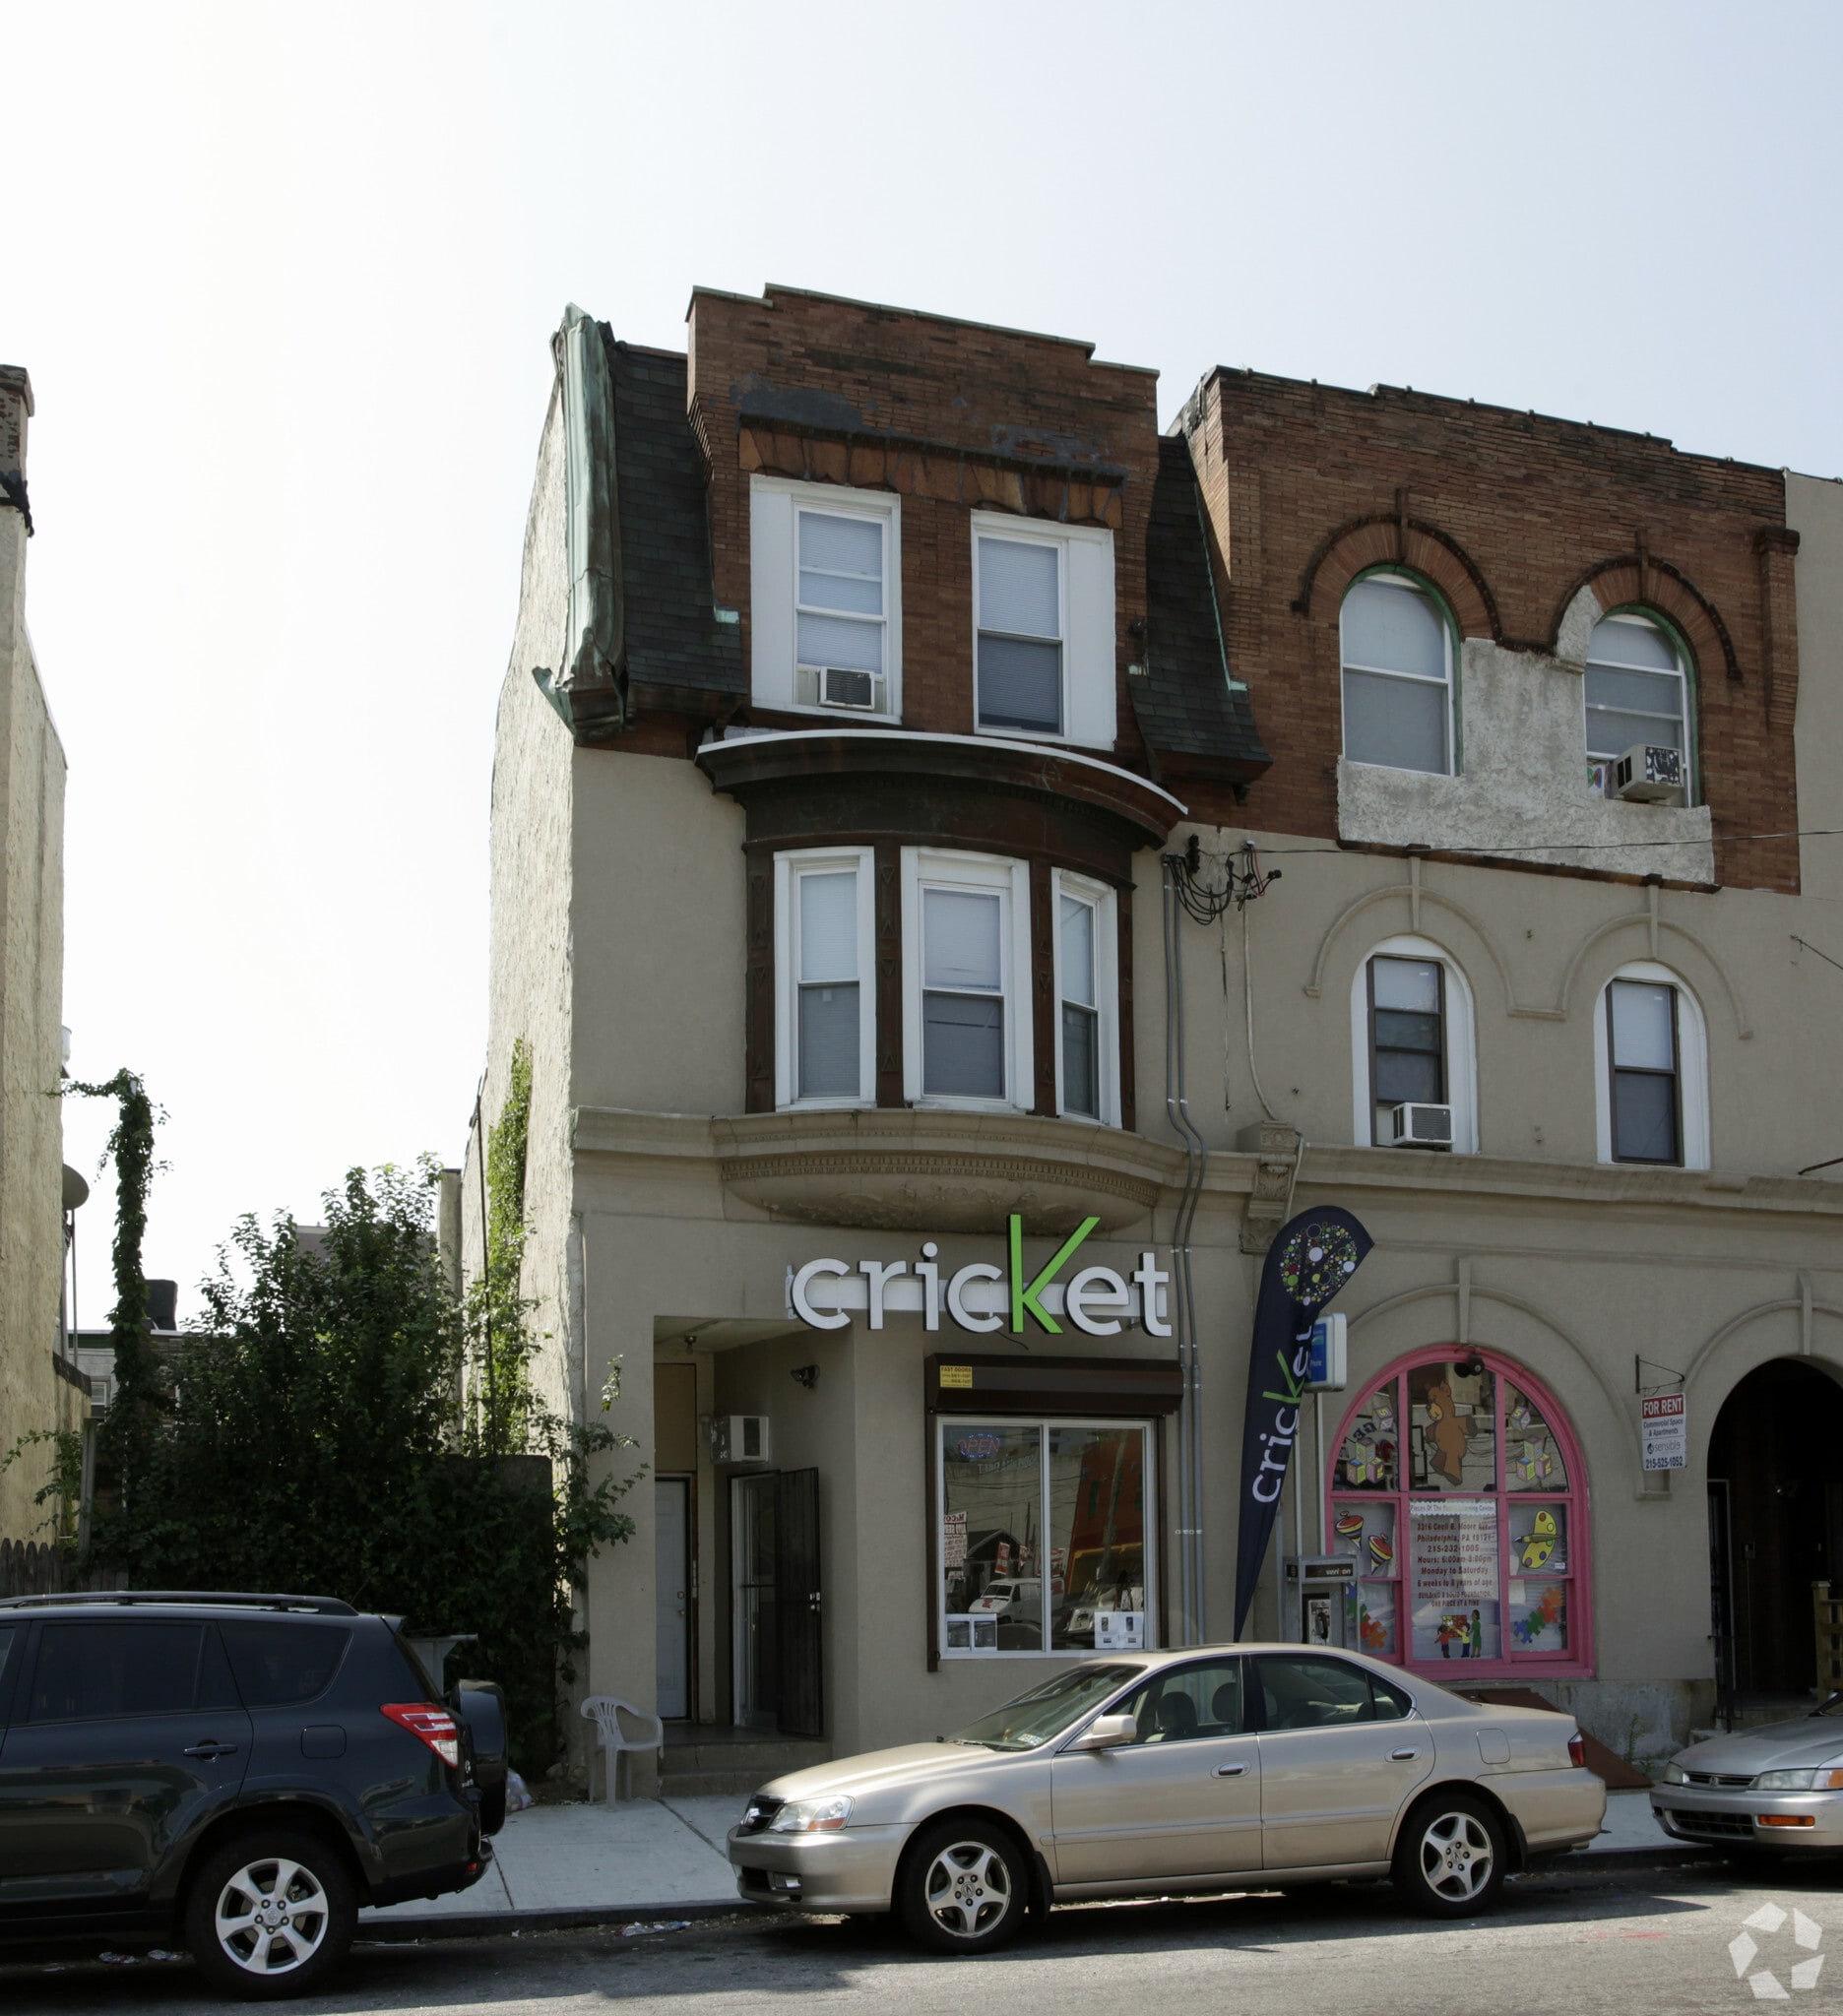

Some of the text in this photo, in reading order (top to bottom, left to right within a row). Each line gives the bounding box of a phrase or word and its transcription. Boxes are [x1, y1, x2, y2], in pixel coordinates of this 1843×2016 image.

[1643, 1398, 1683, 1416] FOR RENT
[1643, 1418, 1684, 1429] Commercial Space
[1654, 1427, 1679, 1437] Apartments
[956, 1438, 1001, 1454] OPEN
[1645, 1456, 1684, 1469] 215-525-1052
[1432, 1522, 1449, 1531] Cecil
[1418, 1534, 1460, 1544] Philadelphia,
[1428, 1544, 1481, 1553] 215-232-1005
[1418, 1555, 1439, 1564] Hours:
[1421, 1566, 1447, 1576] Monday
[1458, 1566, 1489, 1575] Saturday
[1456, 1579, 1472, 1588] years
